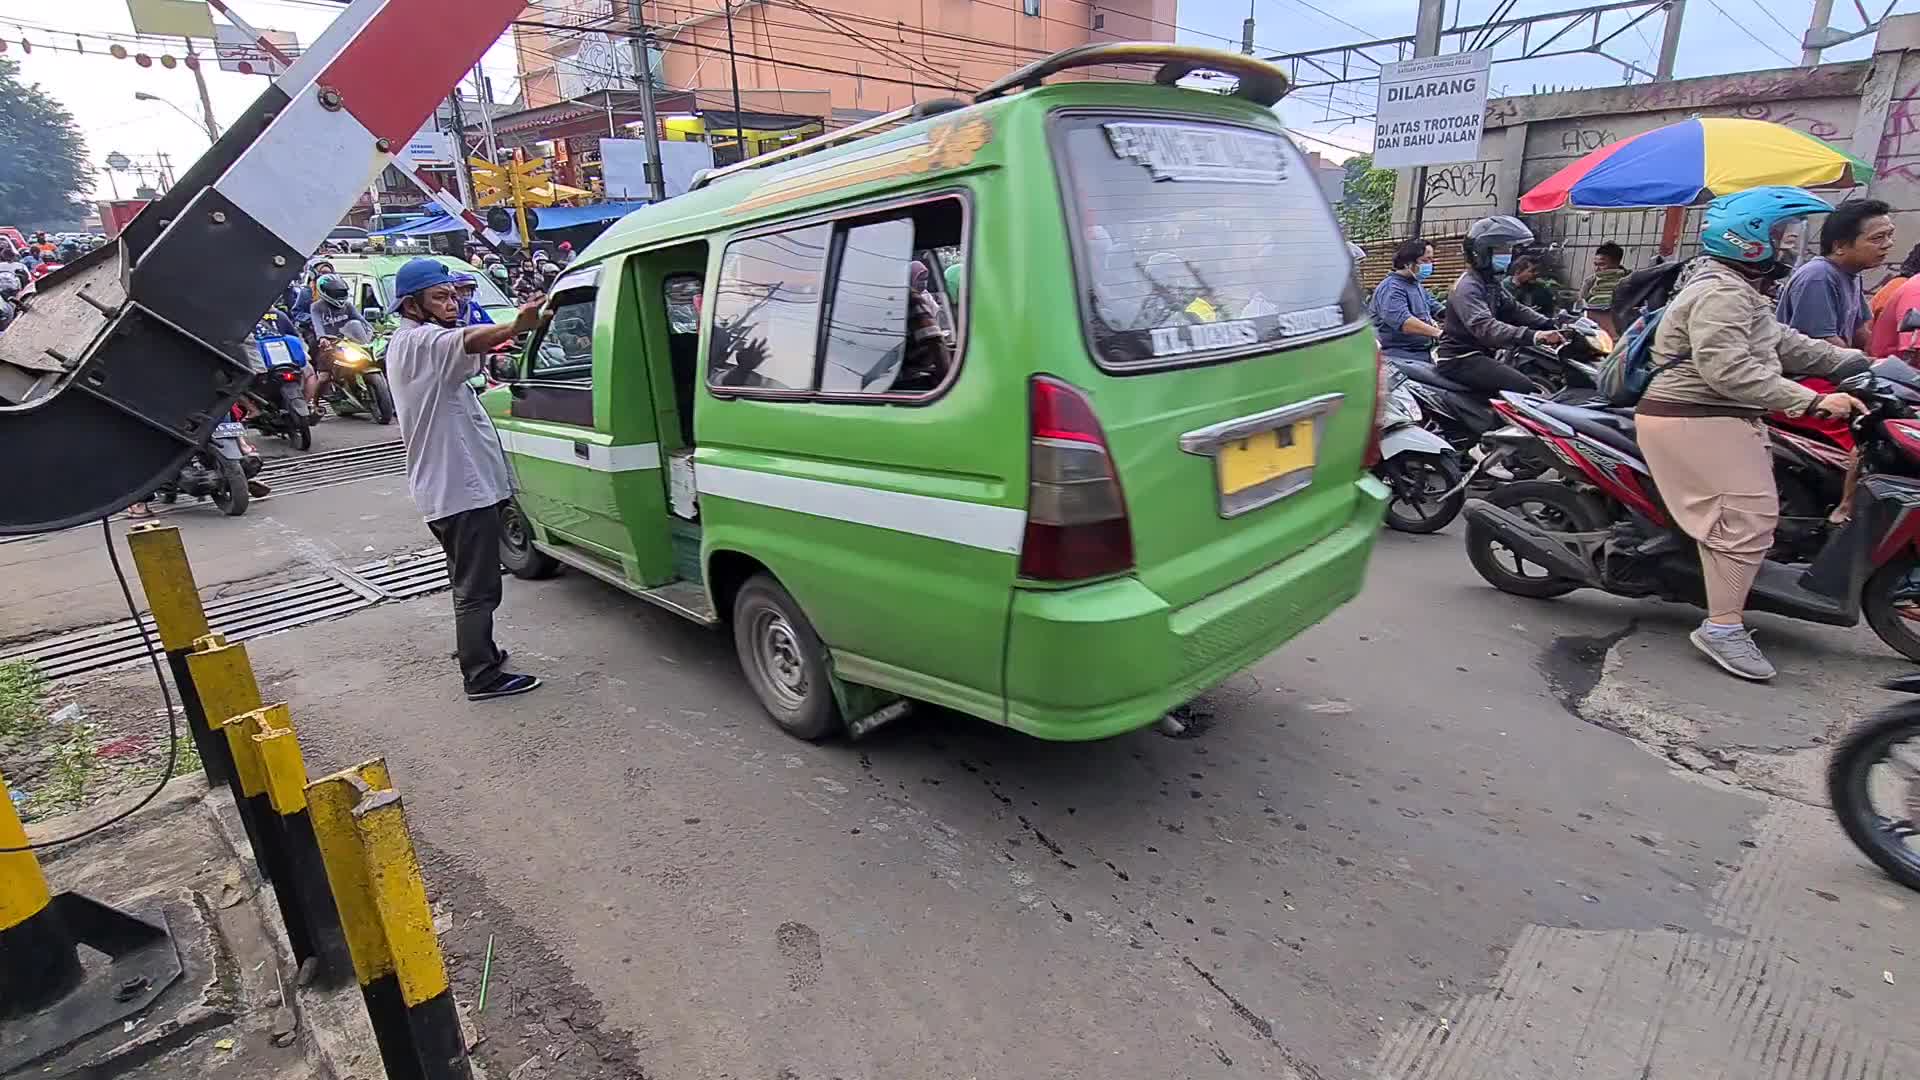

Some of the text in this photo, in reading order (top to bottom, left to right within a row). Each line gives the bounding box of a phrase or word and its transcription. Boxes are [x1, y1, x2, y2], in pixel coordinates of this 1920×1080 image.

[1387, 78, 1476, 102] DILARANG
[1377, 124, 1389, 137] DI
[1391, 121, 1421, 135] ATAS
[1424, 114, 1480, 132] TROTOAR
[1377, 129, 1477, 149] DAN BAHU JALAN
